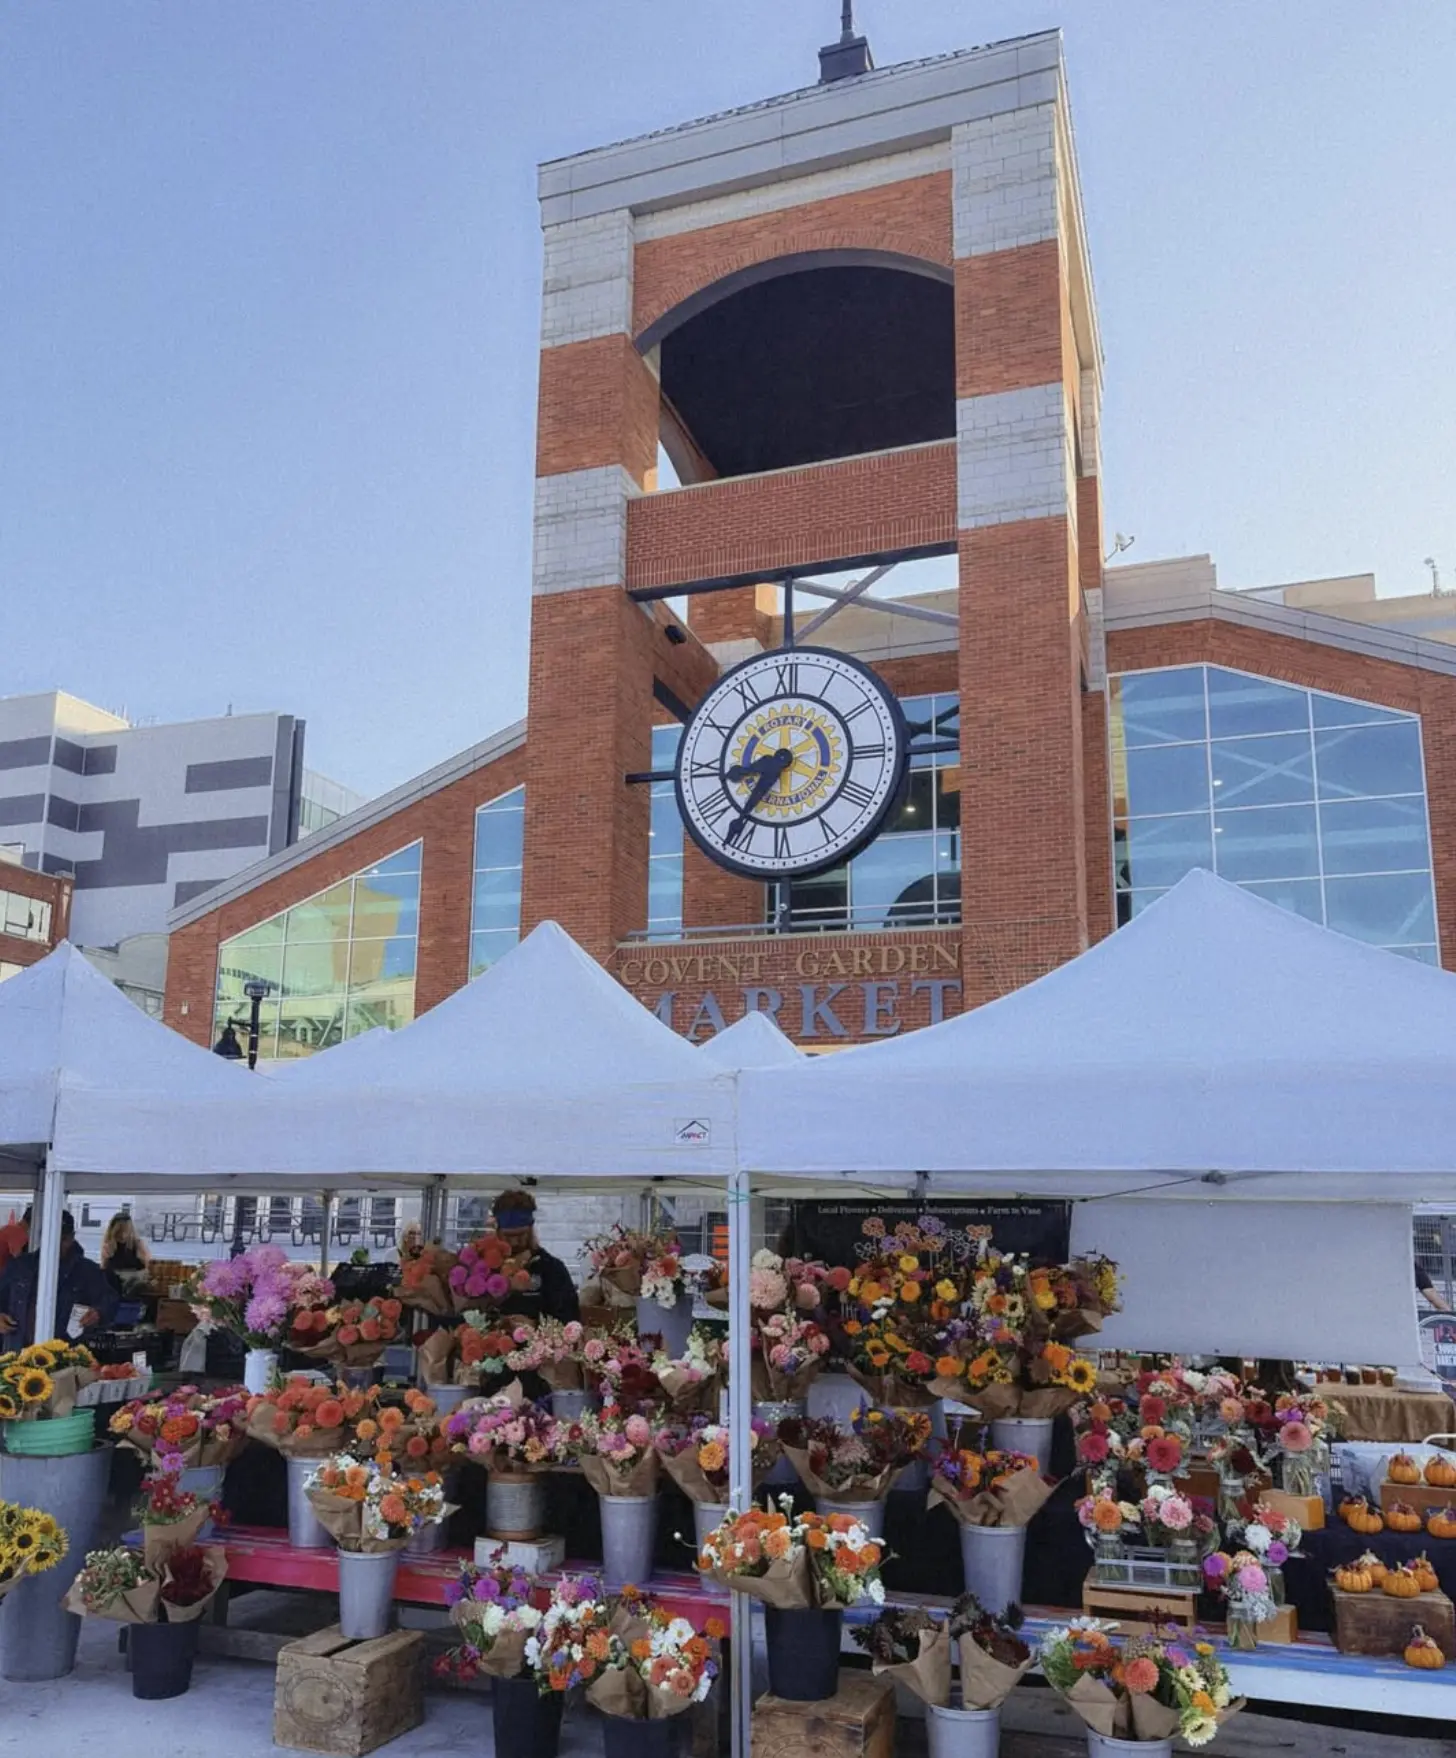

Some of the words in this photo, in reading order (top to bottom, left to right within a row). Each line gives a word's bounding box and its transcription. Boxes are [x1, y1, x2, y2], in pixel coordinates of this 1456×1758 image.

[732, 679, 760, 711] XI
[774, 664, 799, 695] XII
[702, 715, 732, 740] X
[764, 716, 810, 733] ROTARY
[620, 953, 768, 986] COVENT
[795, 942, 962, 977] GARDEN
